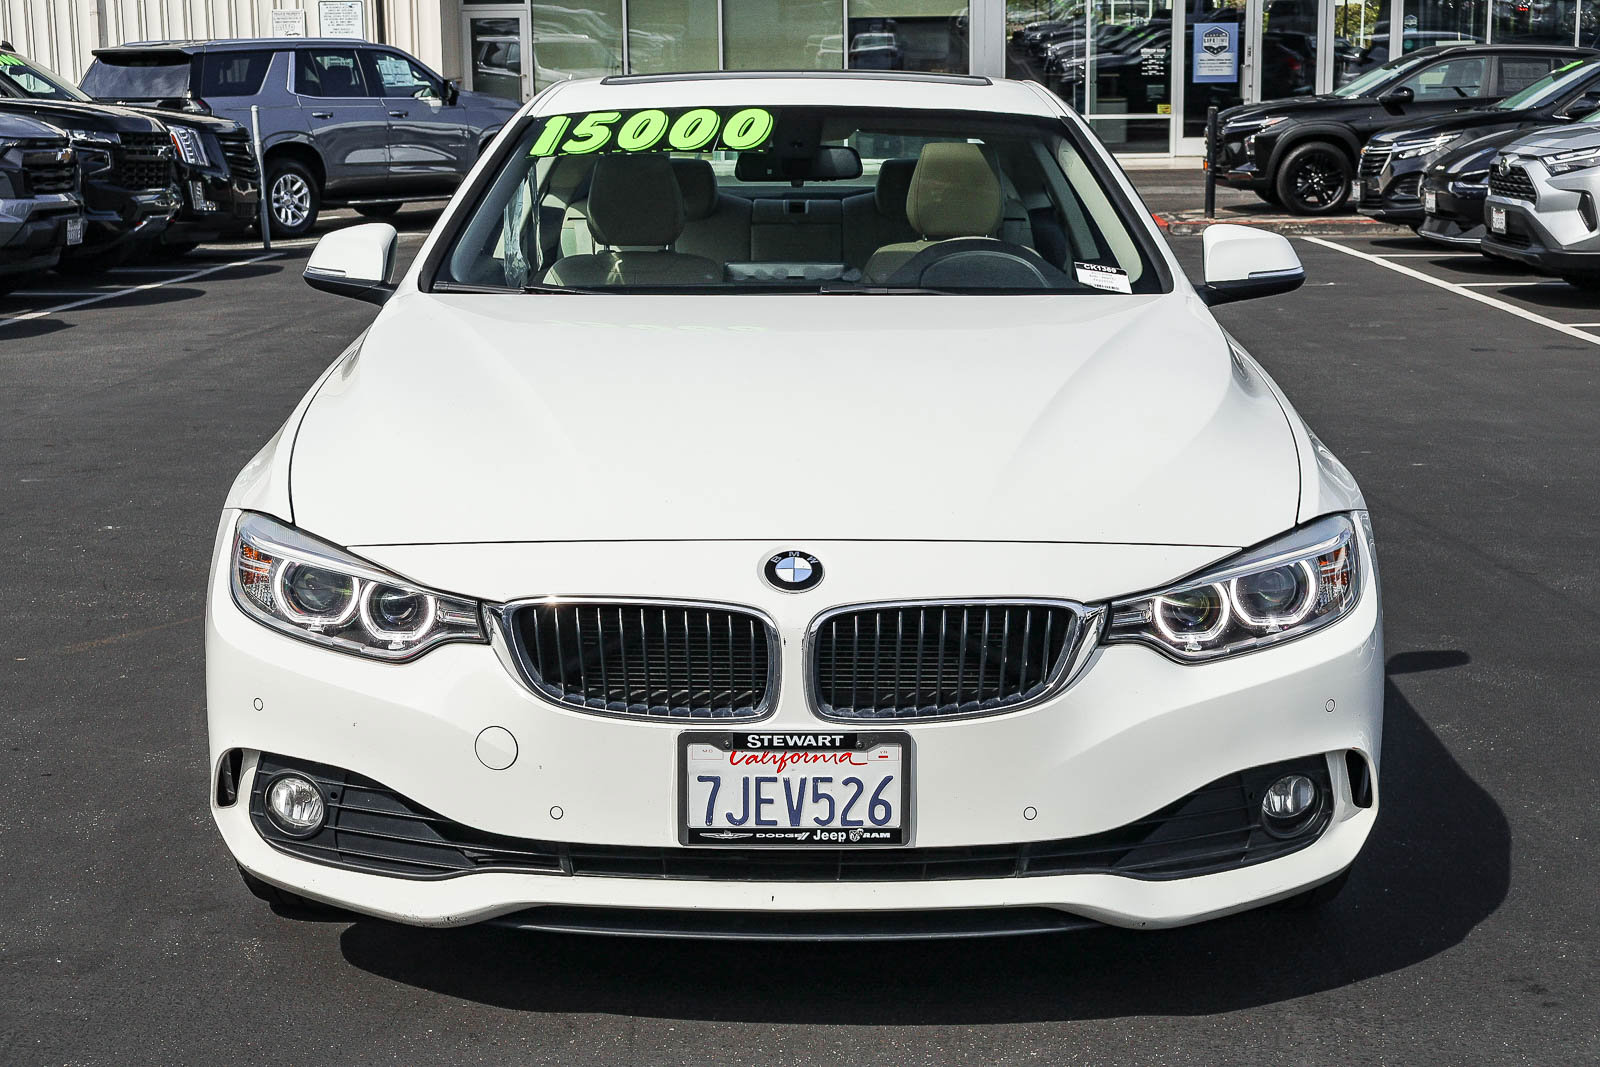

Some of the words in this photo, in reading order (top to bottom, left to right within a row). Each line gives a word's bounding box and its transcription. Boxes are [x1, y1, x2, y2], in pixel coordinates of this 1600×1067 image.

[529, 108, 774, 156] 15000
[770, 551, 819, 564] BMW
[747, 734, 845, 748] STEWART
[730, 750, 868, 774] California
[697, 775, 894, 826] 7JEV526
[813, 830, 847, 843] Jeep
